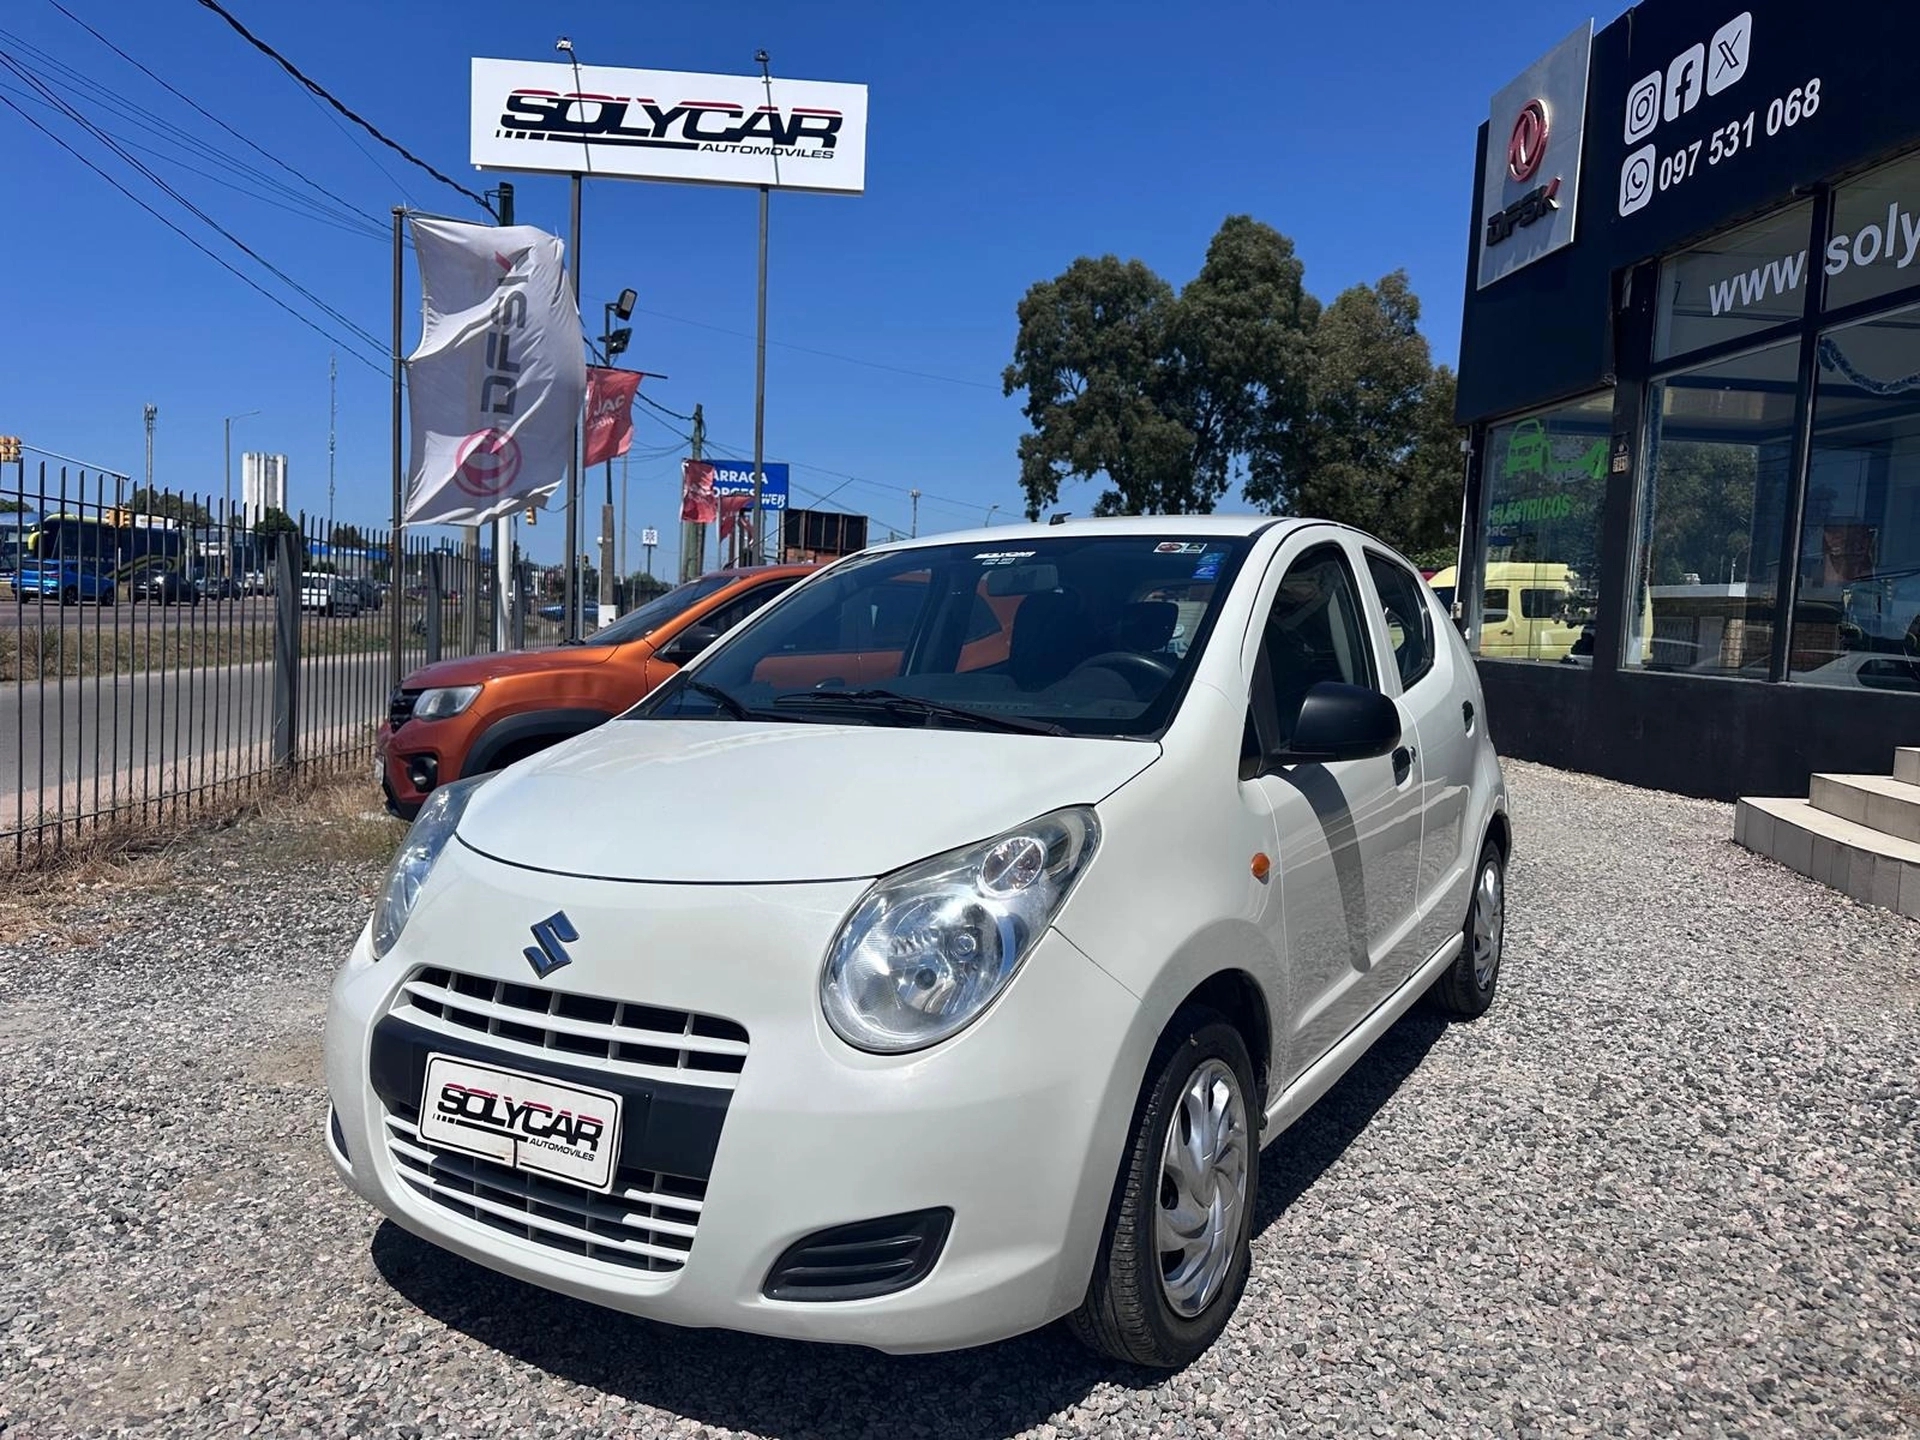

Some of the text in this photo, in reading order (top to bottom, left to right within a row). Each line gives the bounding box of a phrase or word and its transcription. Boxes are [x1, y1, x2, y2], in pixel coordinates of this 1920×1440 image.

[499, 89, 843, 149] SOLYCAR
[1659, 77, 1821, 191] 097 531 068
[701, 143, 835, 160] AUTOMOVILES
[1486, 175, 1561, 247] DFSK
[712, 470, 768, 484] ARRACA
[437, 1082, 604, 1153] SOLYCAR
[529, 1138, 595, 1162] AUTOMOVILES
